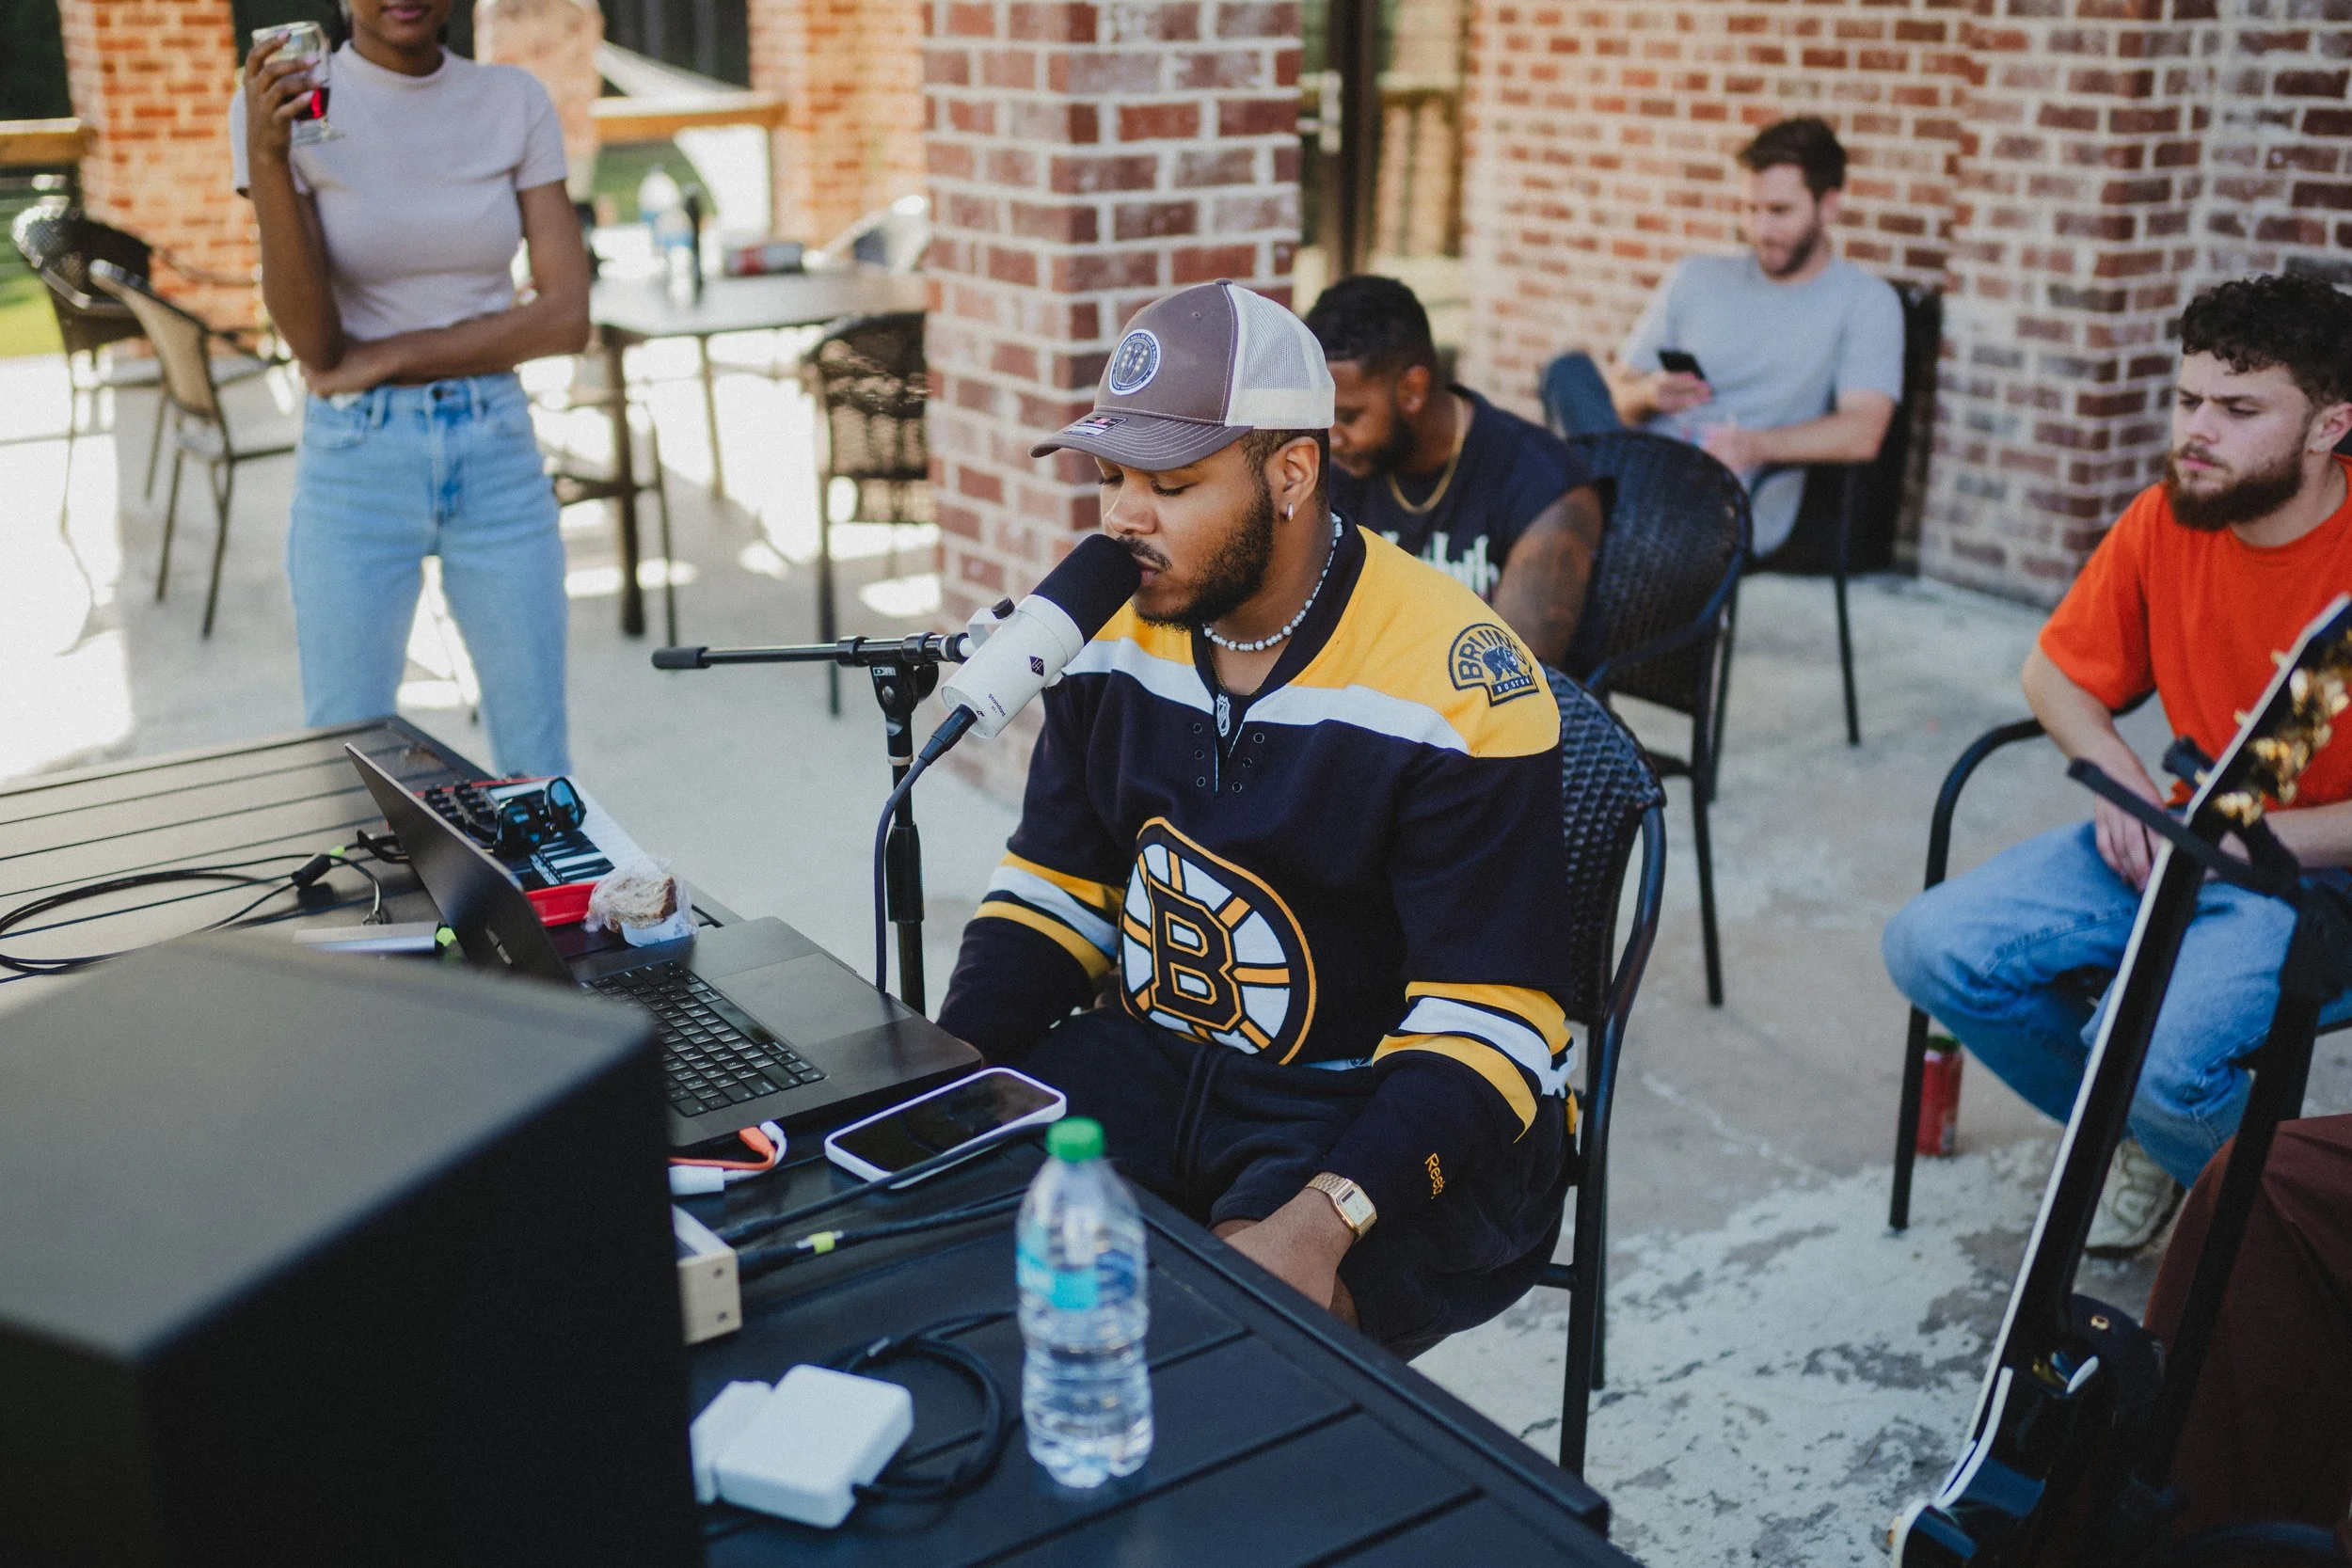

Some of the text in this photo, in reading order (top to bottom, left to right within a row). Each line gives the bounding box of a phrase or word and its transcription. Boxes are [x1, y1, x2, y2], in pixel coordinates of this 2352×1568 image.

[1497, 677, 1532, 693] BOSTON
[988, 693, 1007, 718] Standard
[1147, 876, 1243, 1032] B
